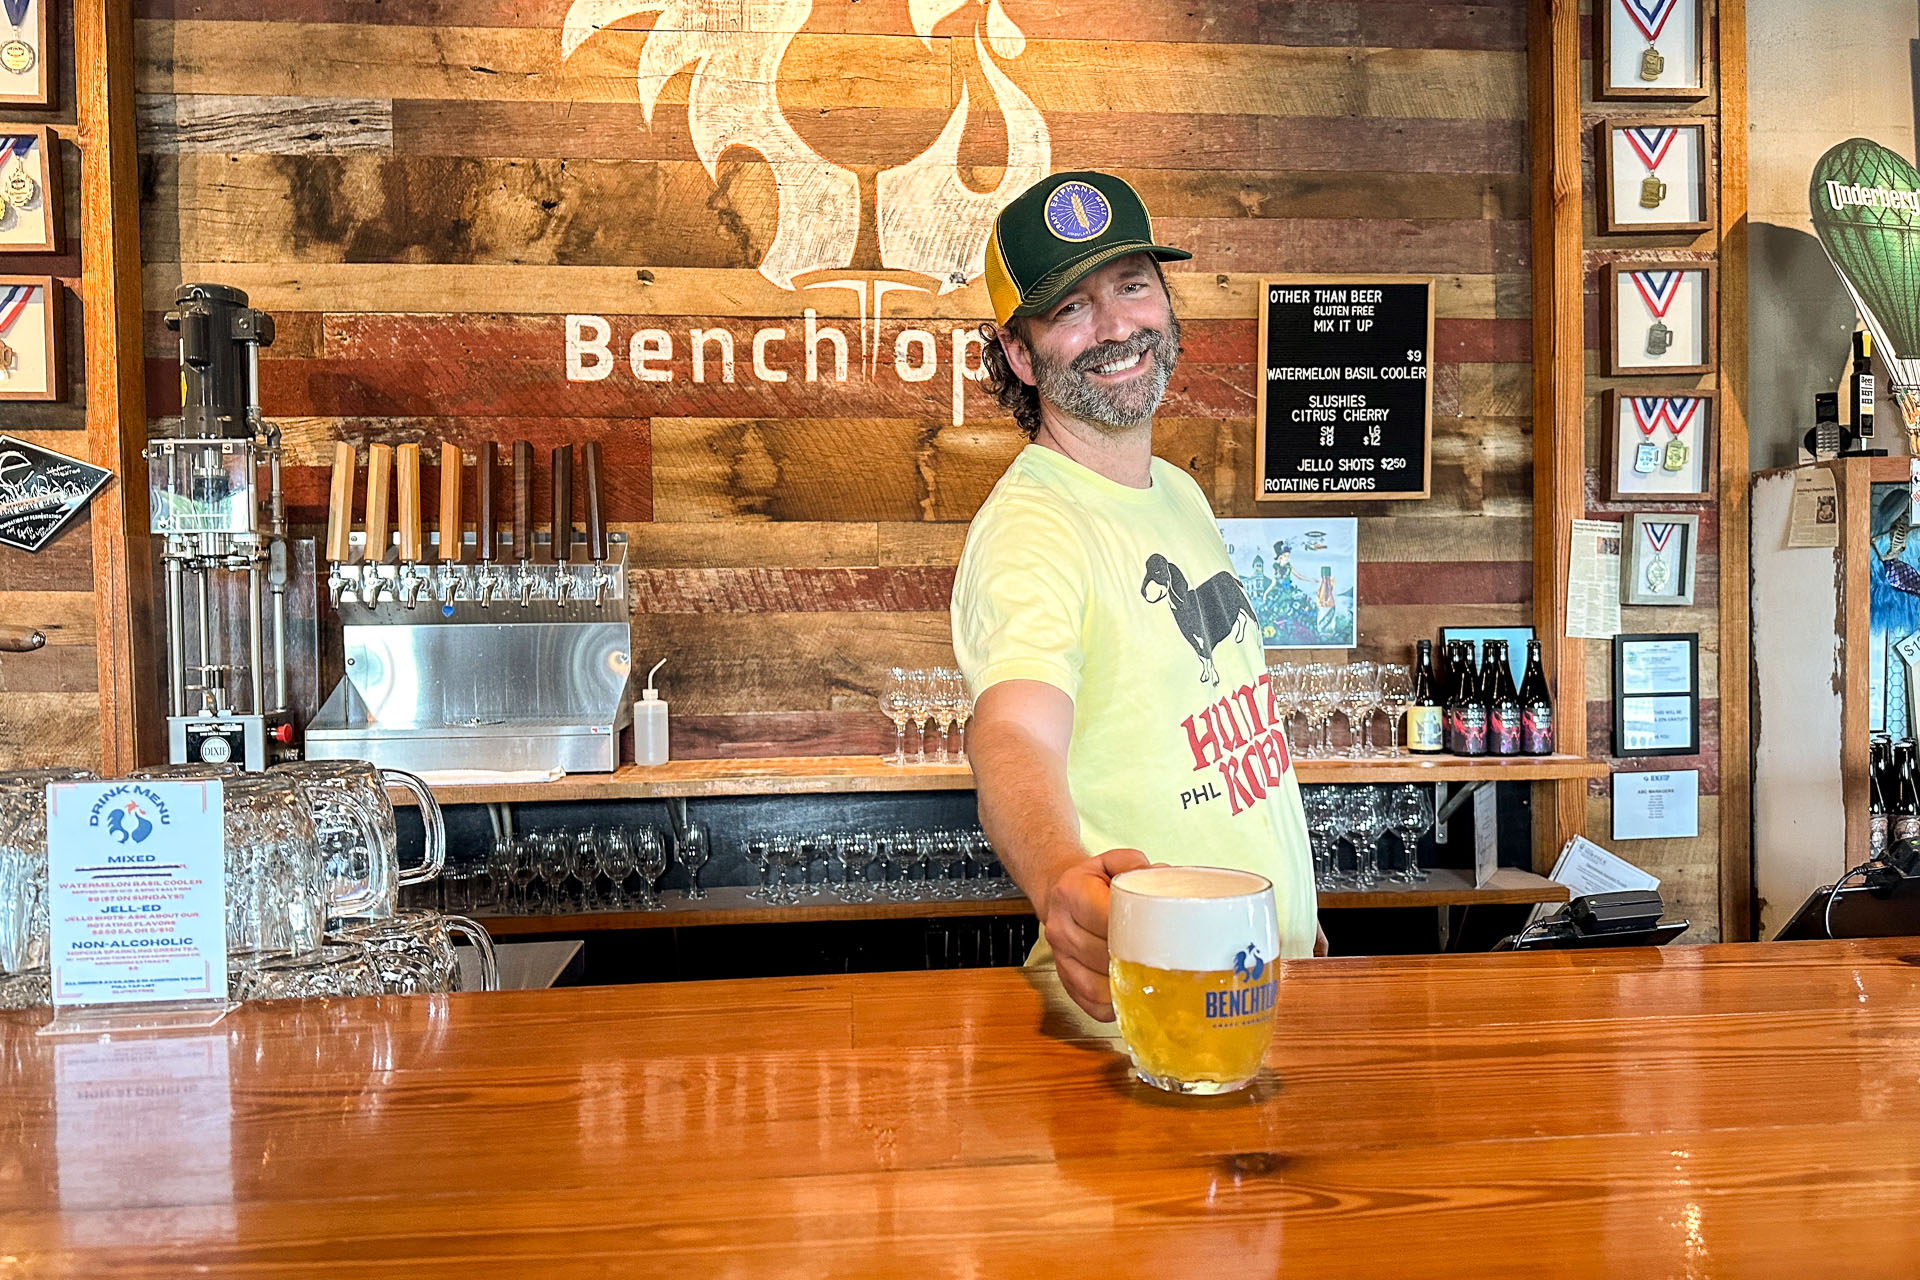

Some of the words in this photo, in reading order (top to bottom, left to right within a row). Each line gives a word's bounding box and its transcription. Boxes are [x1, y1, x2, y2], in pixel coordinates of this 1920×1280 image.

[1050, 184, 1094, 207] EPIPHANY
[1826, 180, 1920, 216] Underberg
[1095, 195, 1107, 216] MALT
[1050, 211, 1065, 232] CRAFT
[1269, 290, 1310, 303] OTHER
[1314, 290, 1347, 303] THAN
[1350, 290, 1382, 303] BEER
[1313, 305, 1349, 316] GLUTEN
[1351, 305, 1375, 316] FREE
[1313, 319, 1334, 332] MIX
[1339, 319, 1351, 332] IT
[1356, 319, 1373, 332] UP
[1406, 349, 1422, 362] $9
[1267, 367, 1340, 380] WATERMELON
[1344, 366, 1378, 380] BASIL
[1380, 366, 1427, 379] COOLER
[1308, 395, 1366, 408] SLUSHIES
[1291, 409, 1337, 422] CITRUS
[1343, 408, 1390, 421] CHERRY
[1320, 426, 1335, 436] SM
[1368, 425, 1381, 435] LG
[1319, 435, 1335, 446] $8
[1363, 434, 1381, 446] $12
[1296, 459, 1334, 472] JELLO
[1338, 458, 1375, 471] SHOTS
[1380, 457, 1406, 470] $250
[1264, 478, 1319, 491] ROTATING
[1322, 477, 1376, 490] FLAVORS
[1180, 782, 1222, 810] PHL
[89, 784, 130, 827] DRINK
[133, 785, 171, 825] MENU
[107, 855, 156, 863] MIXED
[59, 880, 132, 889] WATERMELON
[101, 904, 162, 913] JELL-ED
[72, 937, 193, 949] NON-ALCOHOLIC
